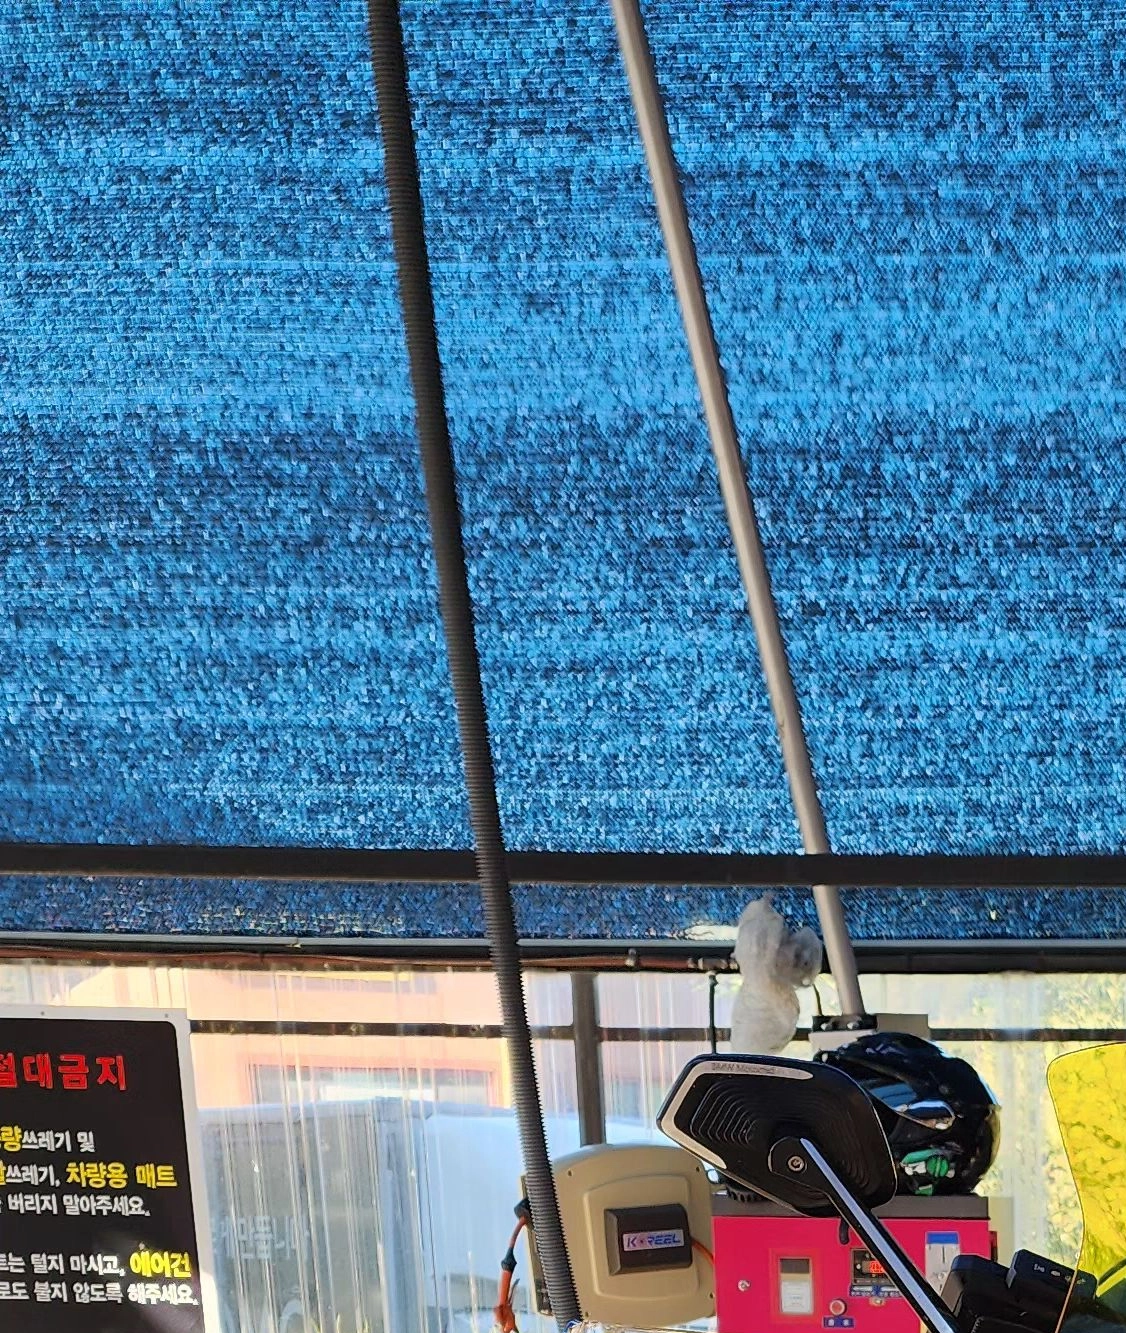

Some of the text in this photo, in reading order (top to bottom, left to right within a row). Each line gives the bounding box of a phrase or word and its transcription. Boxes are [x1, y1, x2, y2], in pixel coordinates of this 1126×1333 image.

[77, 1131, 95, 1152] 및
[66, 1162, 128, 1188] 차량용
[135, 1164, 177, 1188] 매트
[8, 1194, 57, 1214] 버리지
[31, 1253, 64, 1274] 털지
[130, 1252, 192, 1278] 에어건
[34, 1281, 68, 1302] 불지
[73, 1282, 124, 1303] 않도록
